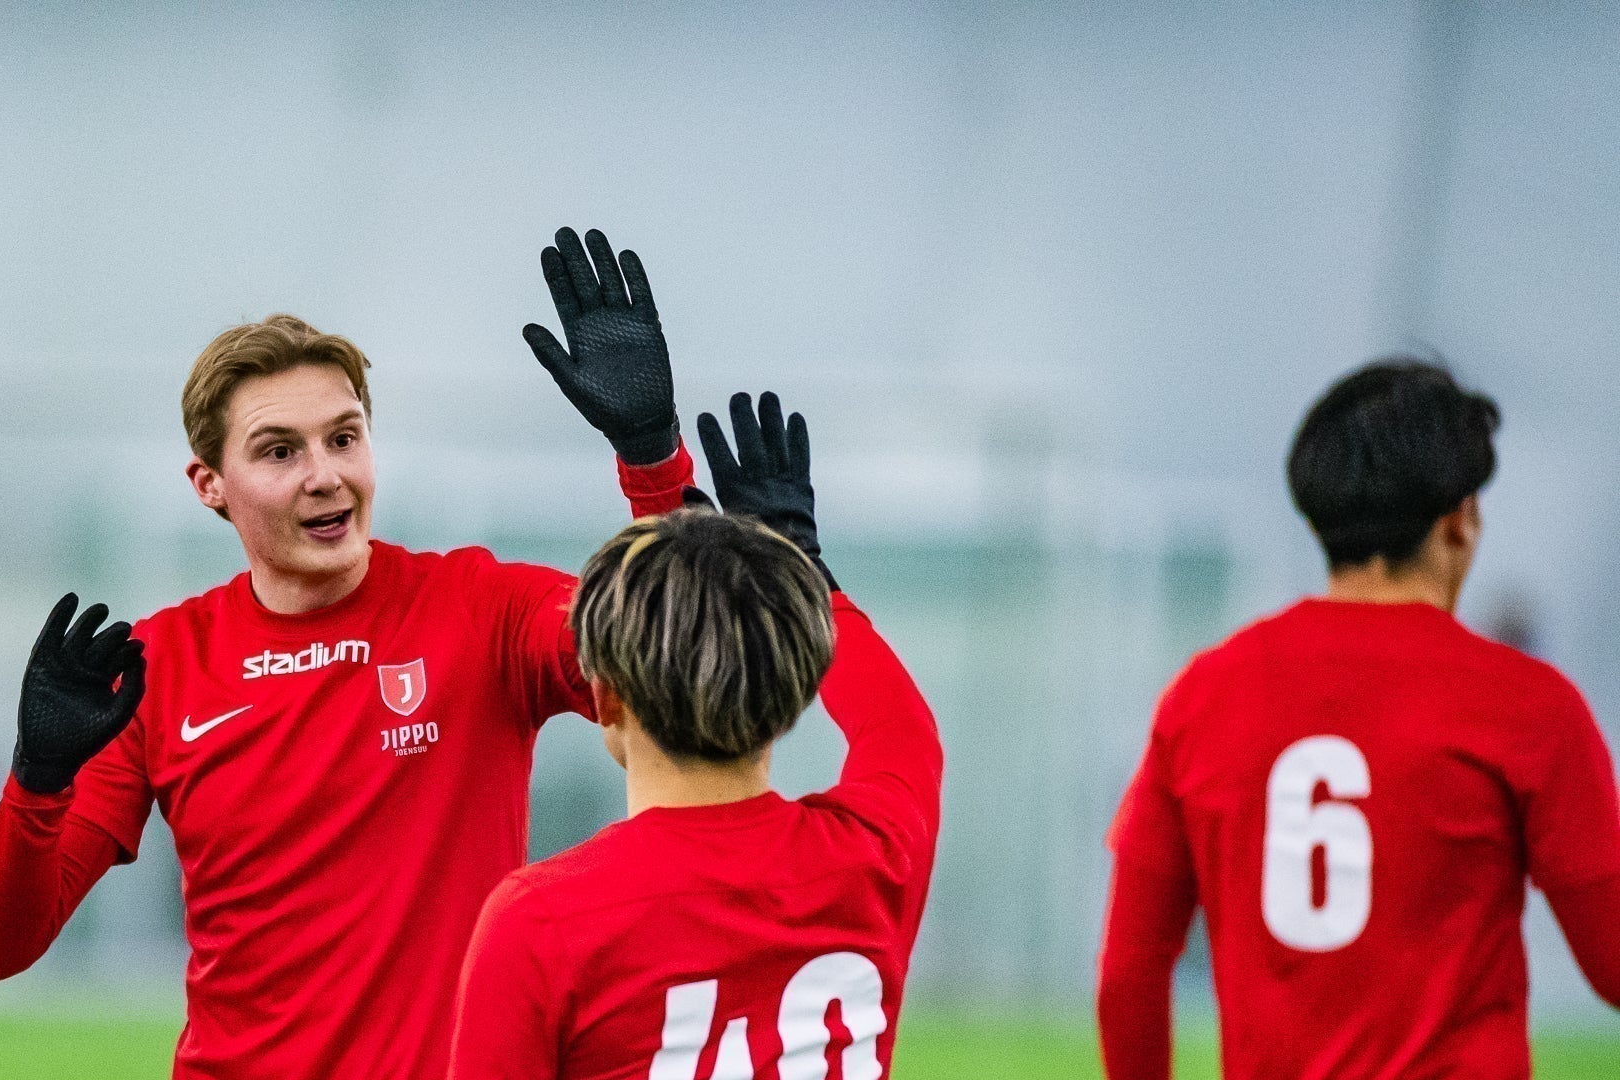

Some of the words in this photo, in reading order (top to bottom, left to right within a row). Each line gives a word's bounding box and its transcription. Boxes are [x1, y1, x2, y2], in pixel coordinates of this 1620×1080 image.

[242, 639, 370, 680] stadium
[398, 673, 413, 704] J
[380, 721, 439, 751] JIPPO
[395, 745, 428, 757] JOENSUU
[1261, 734, 1373, 953] 6
